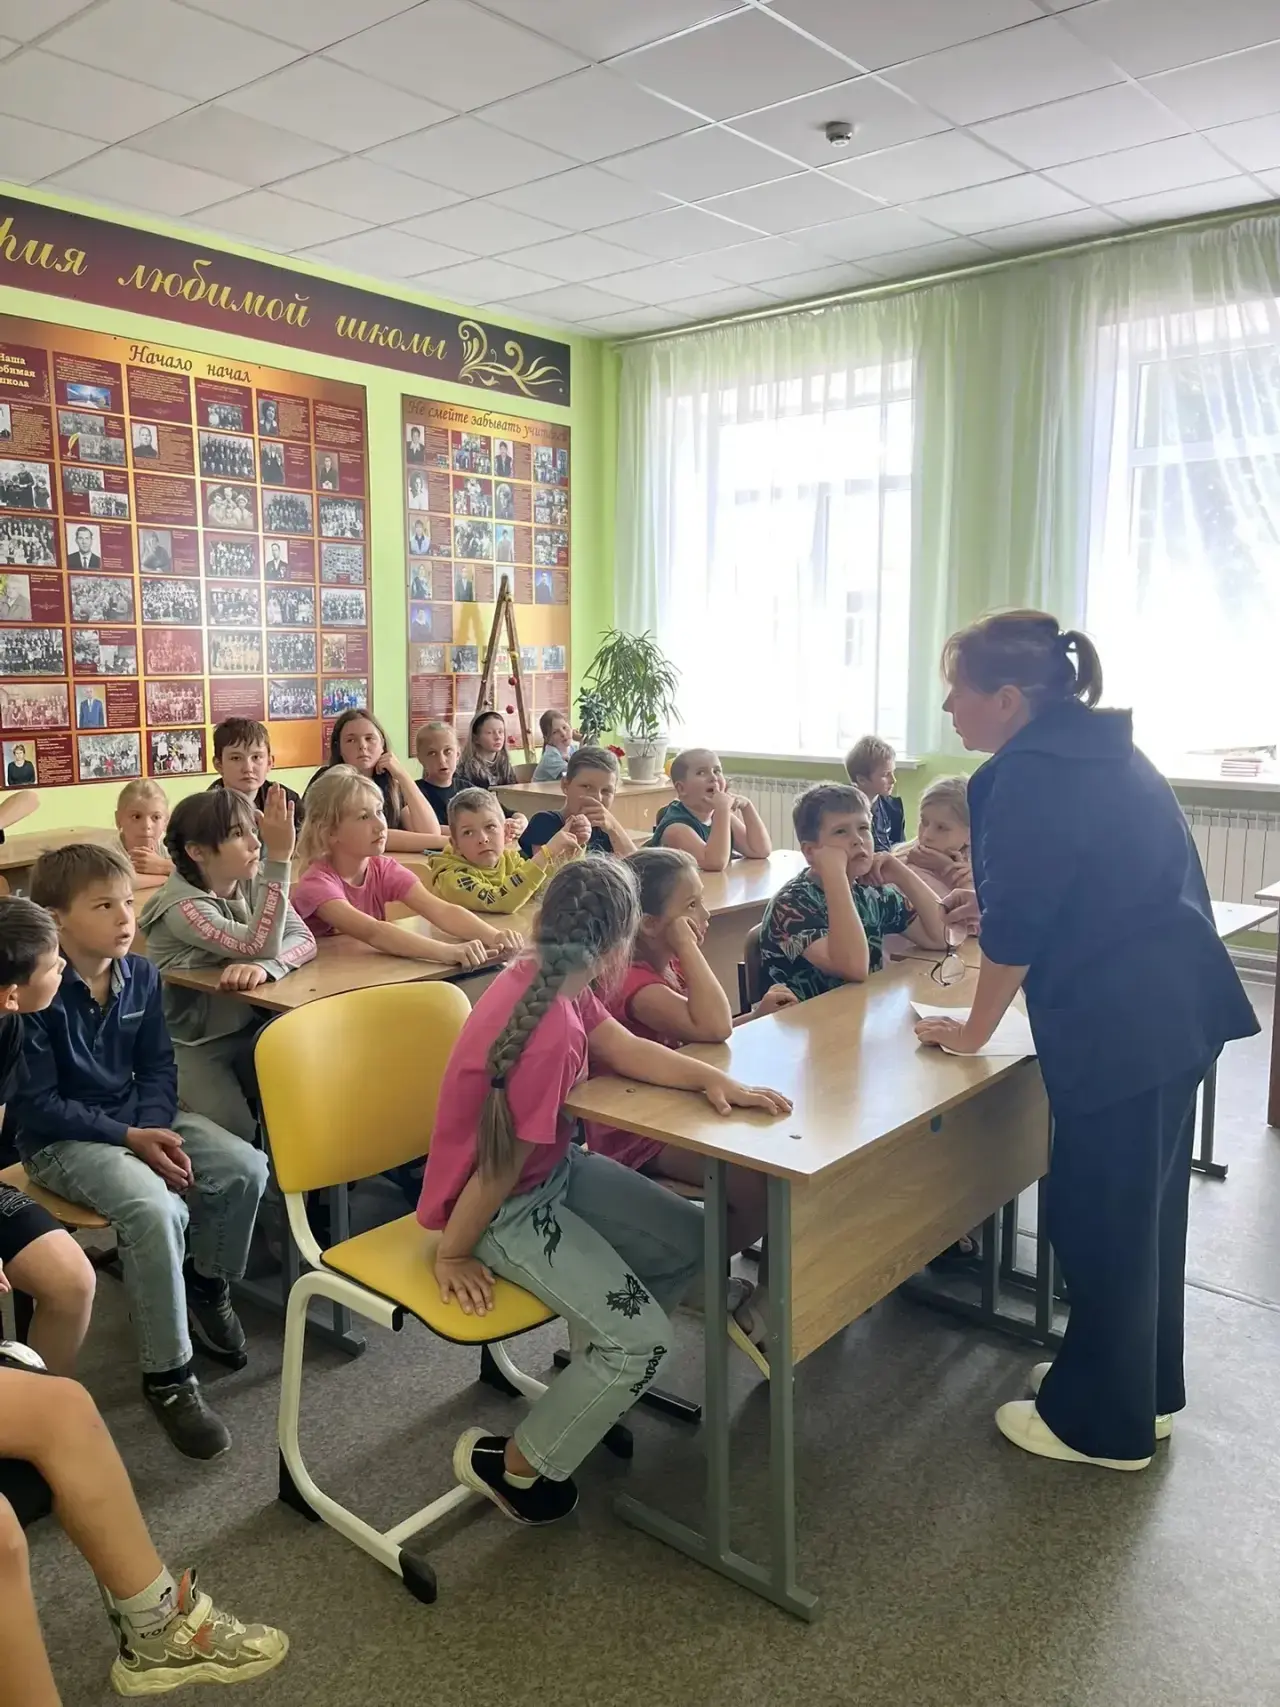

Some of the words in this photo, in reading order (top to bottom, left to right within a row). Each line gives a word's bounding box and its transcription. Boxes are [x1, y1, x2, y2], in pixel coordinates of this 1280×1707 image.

[118, 259, 311, 329] любимой
[335, 316, 448, 362] школы
[129, 344, 193, 371] Начало
[207, 363, 252, 383] начал
[408, 400, 426, 416] Не
[428, 407, 469, 424] смейте
[471, 411, 522, 434] забывать
[263, 890, 280, 917] THERE
[629, 1345, 668, 1397] dreamer
